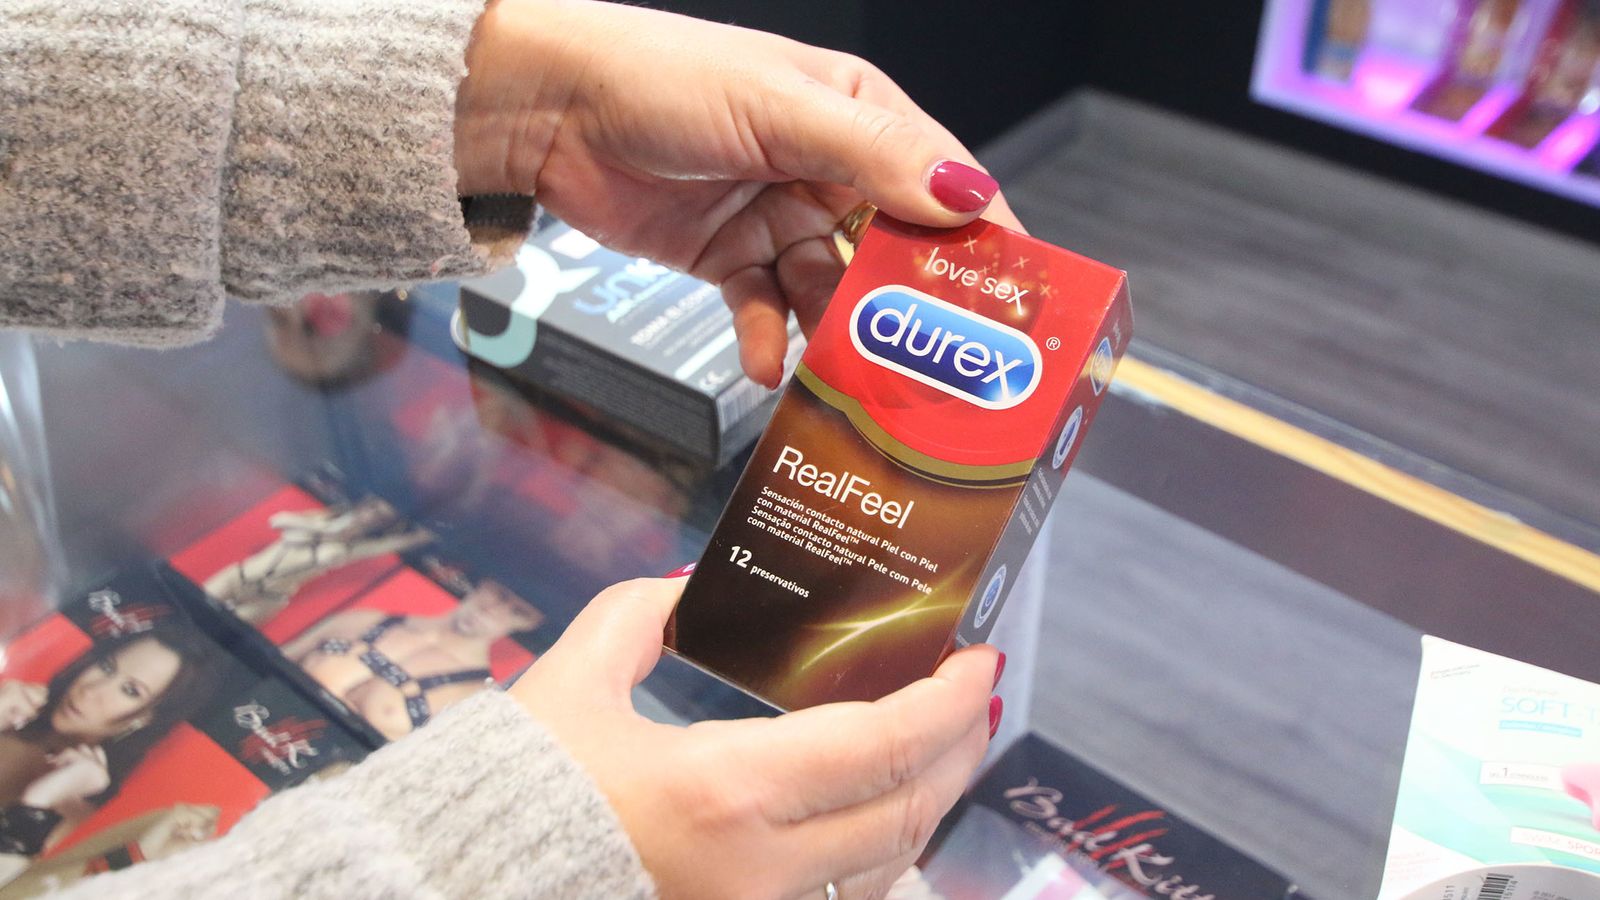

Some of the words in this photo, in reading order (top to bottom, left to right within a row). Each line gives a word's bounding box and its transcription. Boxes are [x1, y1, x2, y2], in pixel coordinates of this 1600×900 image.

[924, 247, 979, 287] love
[981, 276, 1029, 316] sex
[869, 303, 1023, 401] durex
[756, 497, 773, 510] con
[774, 504, 811, 526] material
[772, 445, 915, 529] RealFeel
[747, 515, 766, 530] com
[767, 525, 804, 547] material
[751, 505, 791, 529] Sensação
[793, 526, 832, 549] contacto
[833, 541, 867, 565] natural
[867, 558, 888, 574] Pele
[889, 570, 909, 584] com
[911, 579, 933, 595] Pele
[761, 486, 804, 512] Sensación
[805, 506, 845, 530] contacto
[846, 523, 879, 547] natural
[880, 539, 899, 555] Piel
[900, 550, 918, 563] con
[919, 558, 938, 573] Piel
[729, 545, 753, 568] 12
[750, 565, 810, 598] preservativos
